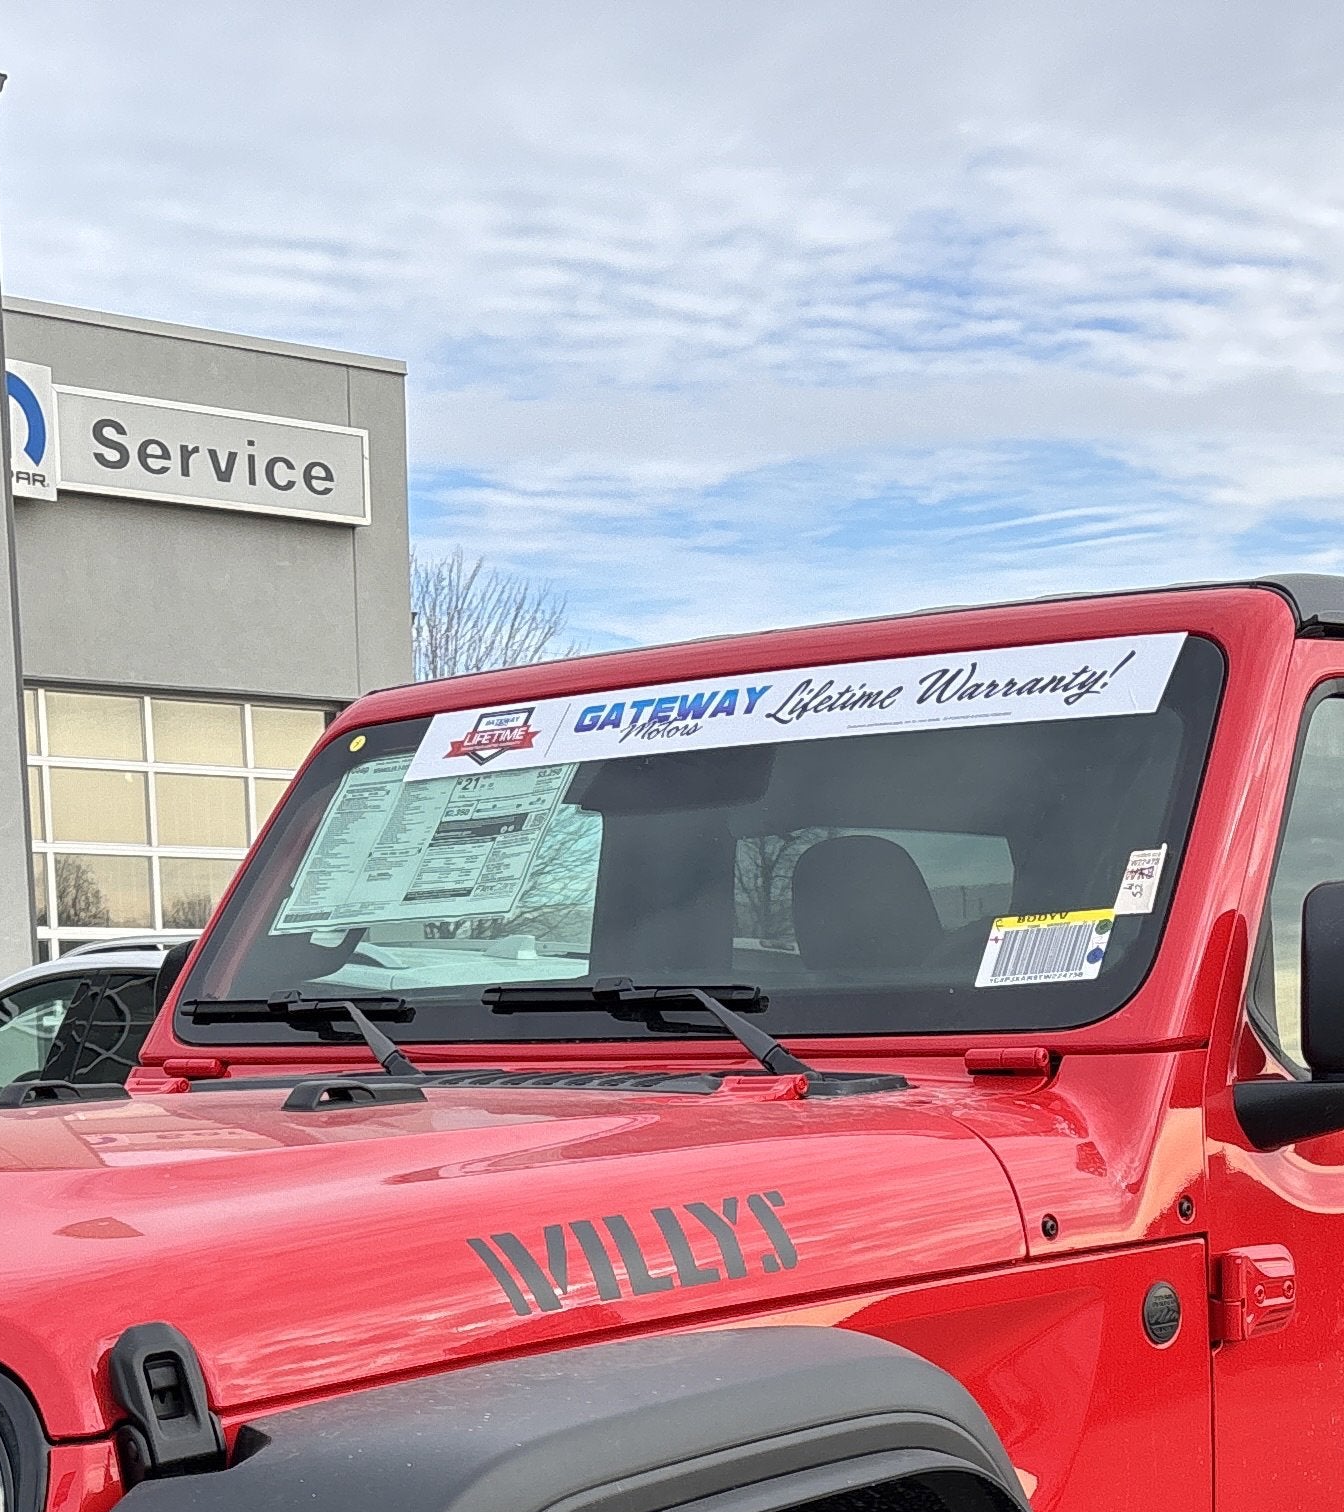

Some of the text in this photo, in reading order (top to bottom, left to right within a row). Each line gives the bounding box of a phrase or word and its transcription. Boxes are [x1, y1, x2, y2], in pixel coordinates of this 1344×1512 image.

[92, 418, 336, 497] Service
[573, 650, 1137, 733] GATEWAY Lifetime Warranty!
[463, 727, 527, 746] LIFETIME
[618, 716, 703, 744] Motors
[462, 777, 480, 791] 21
[466, 1190, 798, 1316] WILLYS
